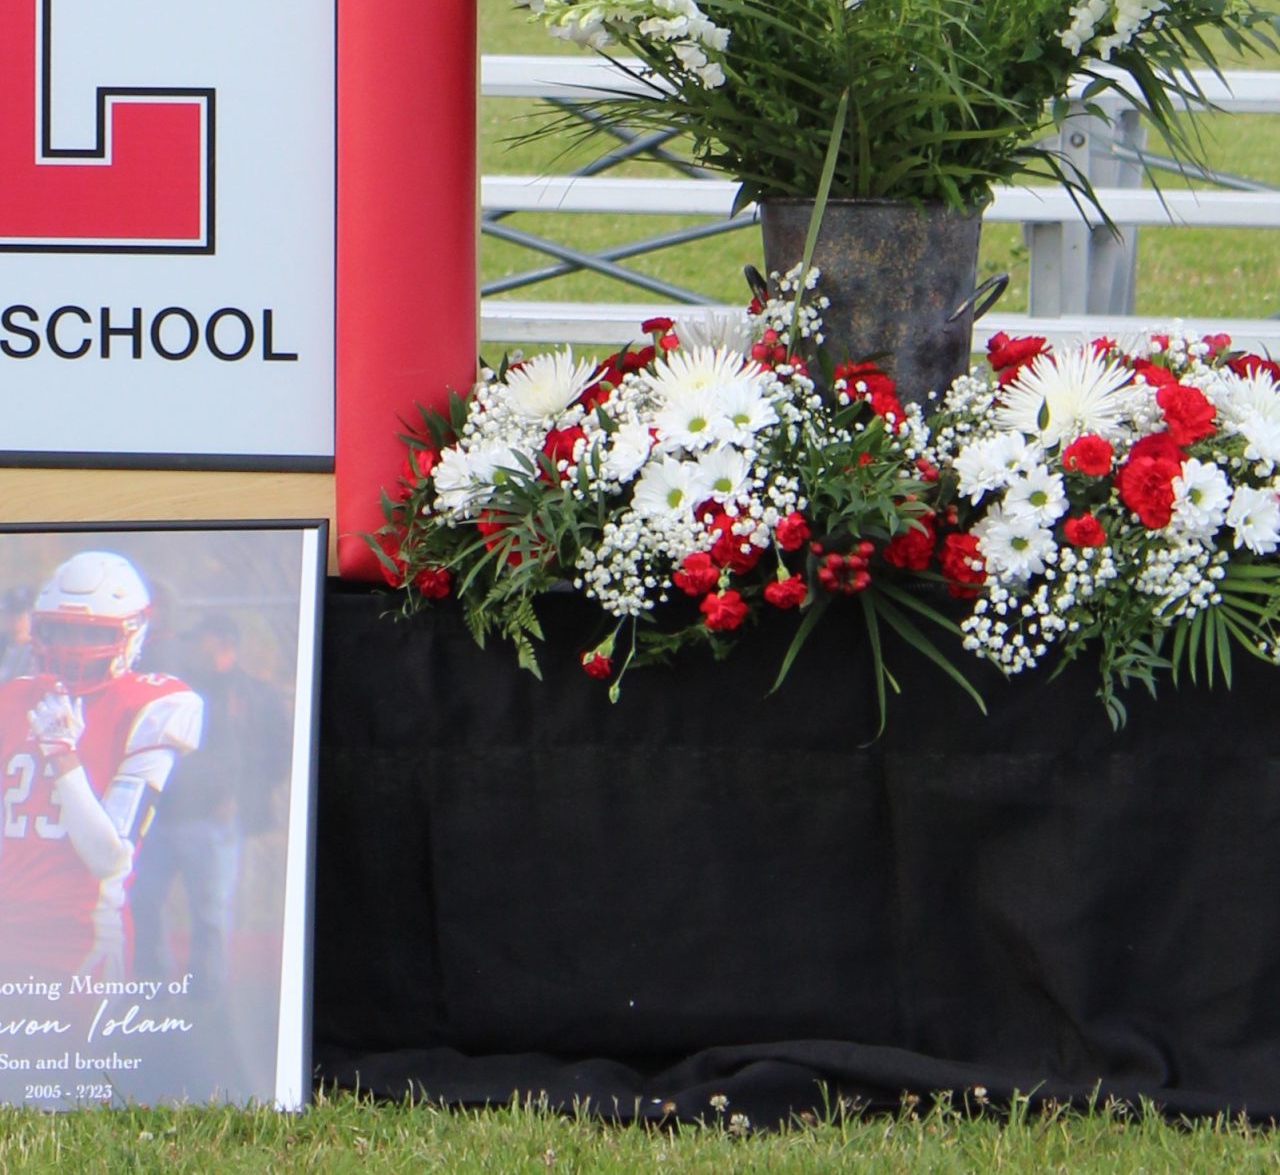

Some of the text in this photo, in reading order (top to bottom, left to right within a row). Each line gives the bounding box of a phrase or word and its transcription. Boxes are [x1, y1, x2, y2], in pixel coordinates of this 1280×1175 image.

[0, 305, 298, 361] SCHOOL
[69, 974, 162, 1000] Memory
[168, 973, 193, 994] of
[36, 1052, 69, 1070] and
[75, 1052, 143, 1070] brother
[25, 1084, 62, 1099] 2005
